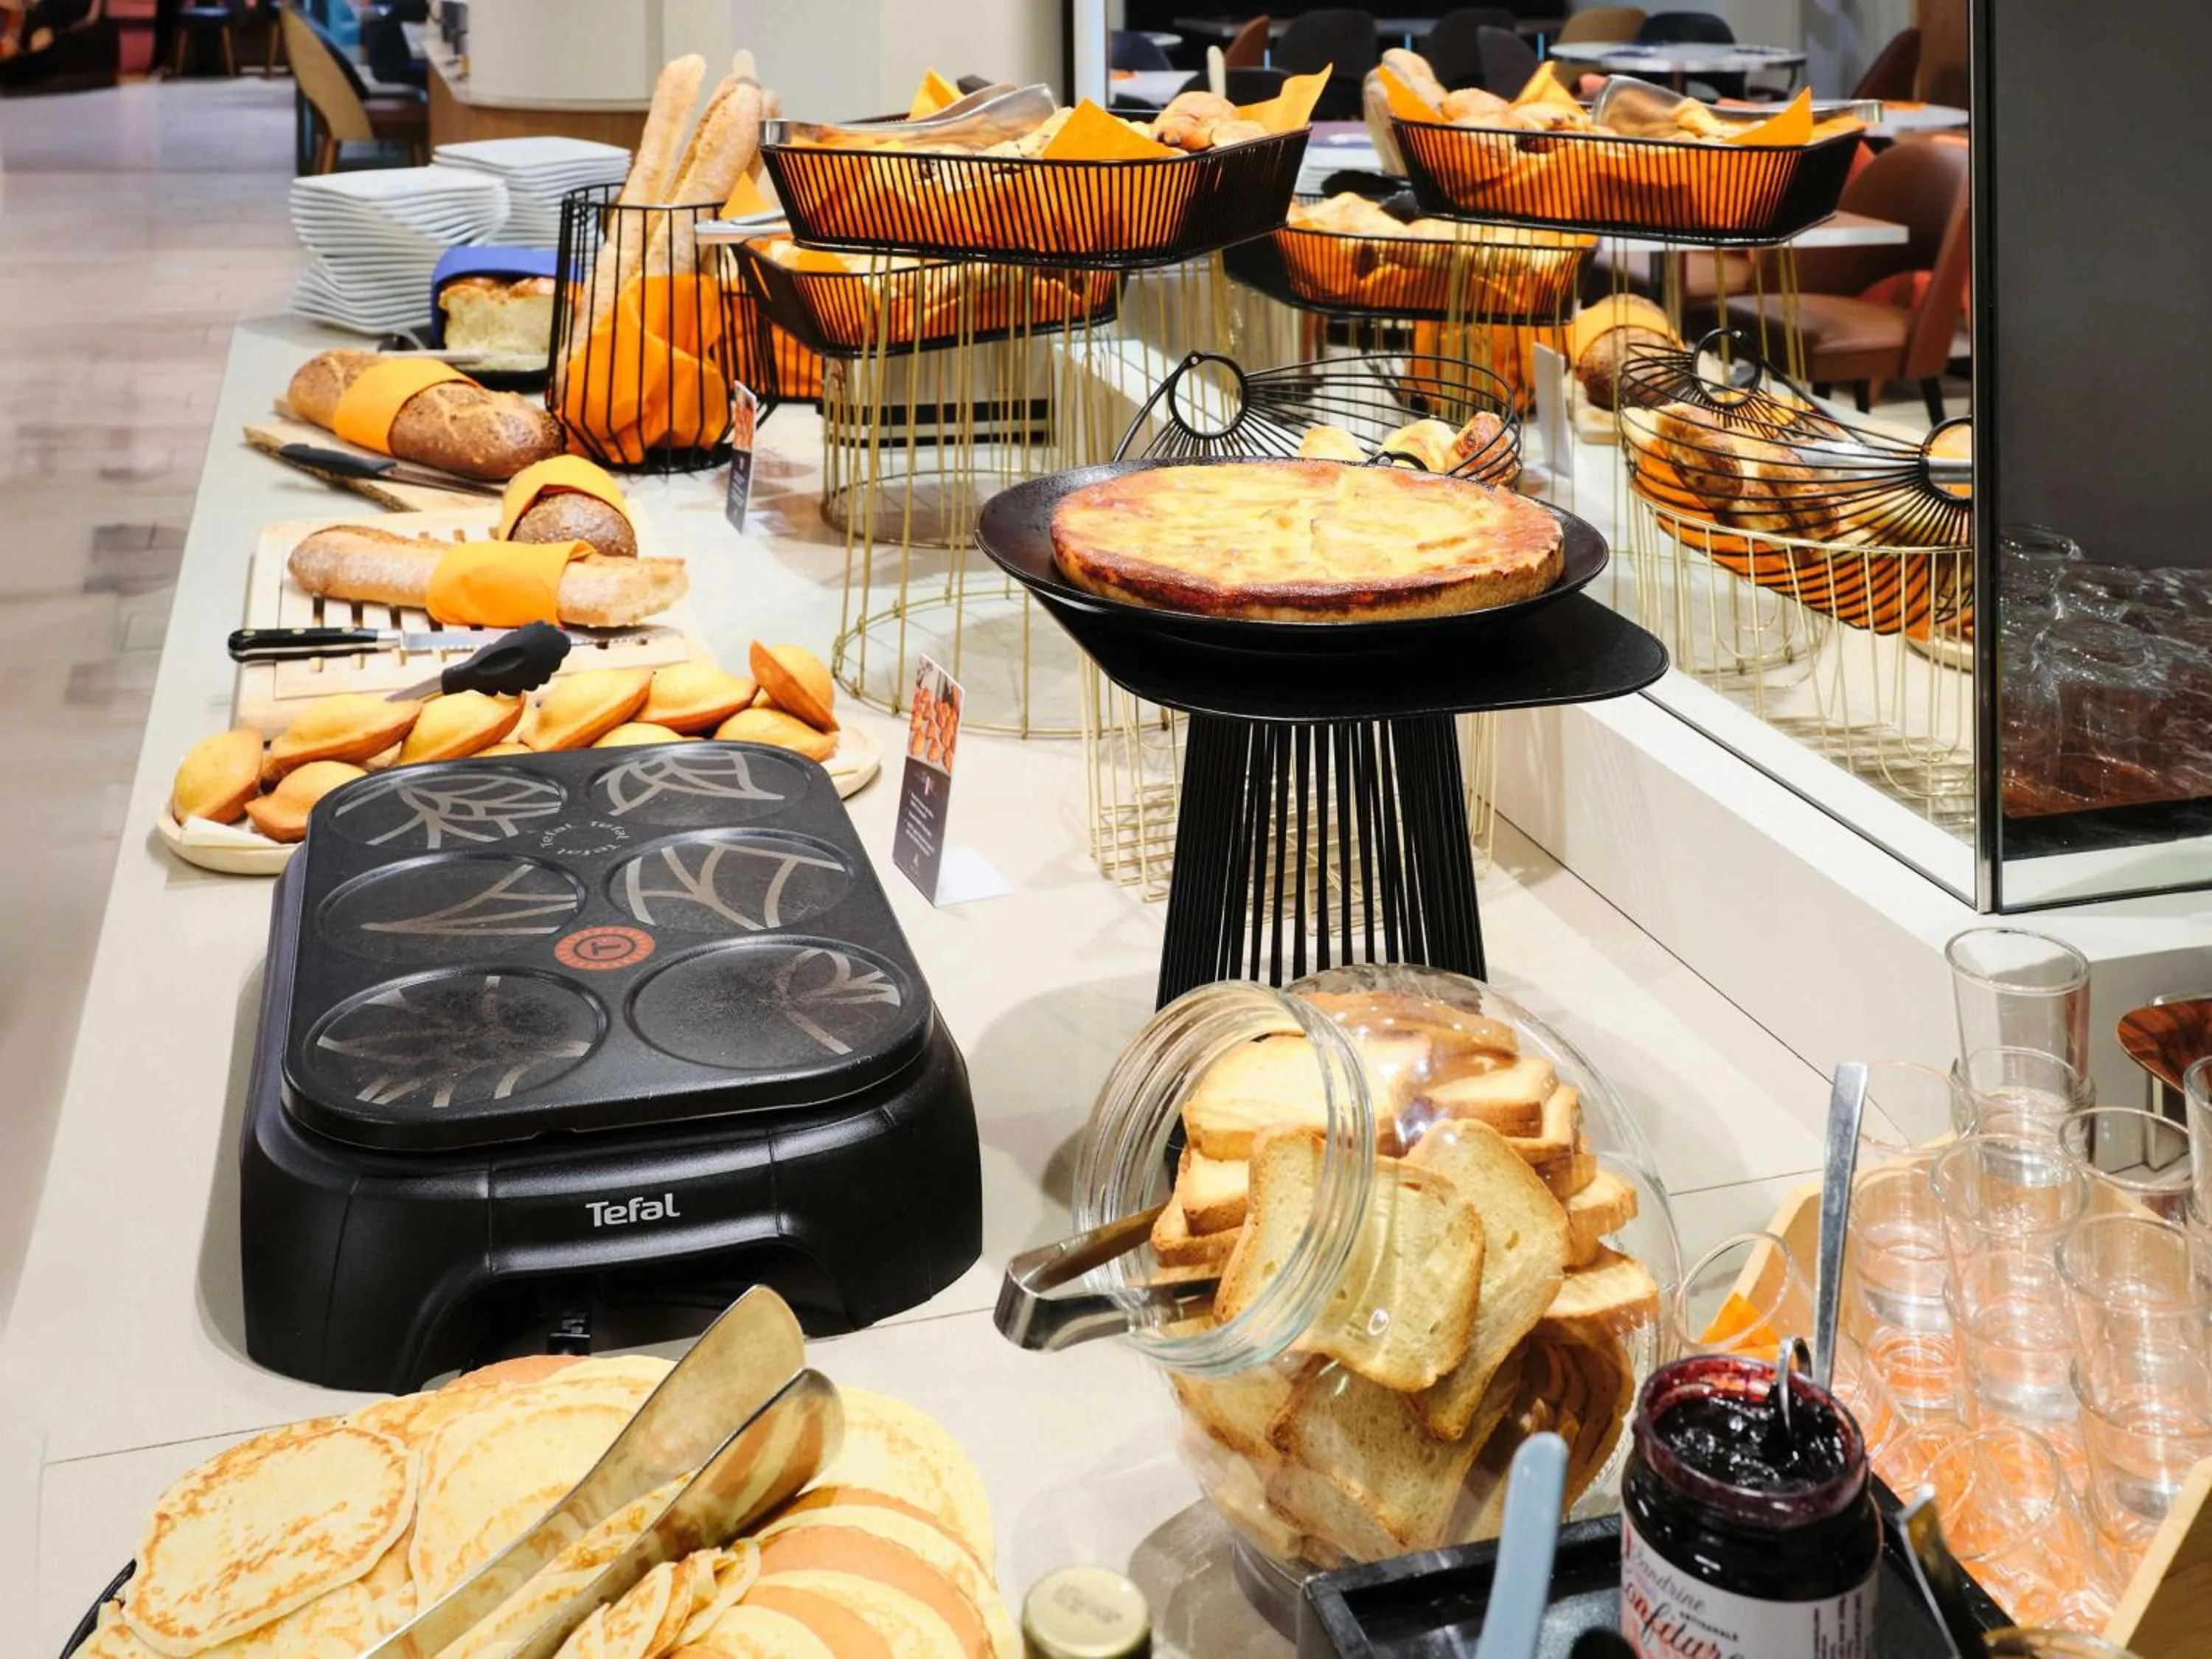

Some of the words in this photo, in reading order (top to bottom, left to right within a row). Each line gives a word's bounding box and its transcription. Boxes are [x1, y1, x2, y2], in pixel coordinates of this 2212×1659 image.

[540, 823, 577, 848] Tefal
[590, 821, 630, 841] Tefal
[585, 1192, 681, 1228] Tefal
